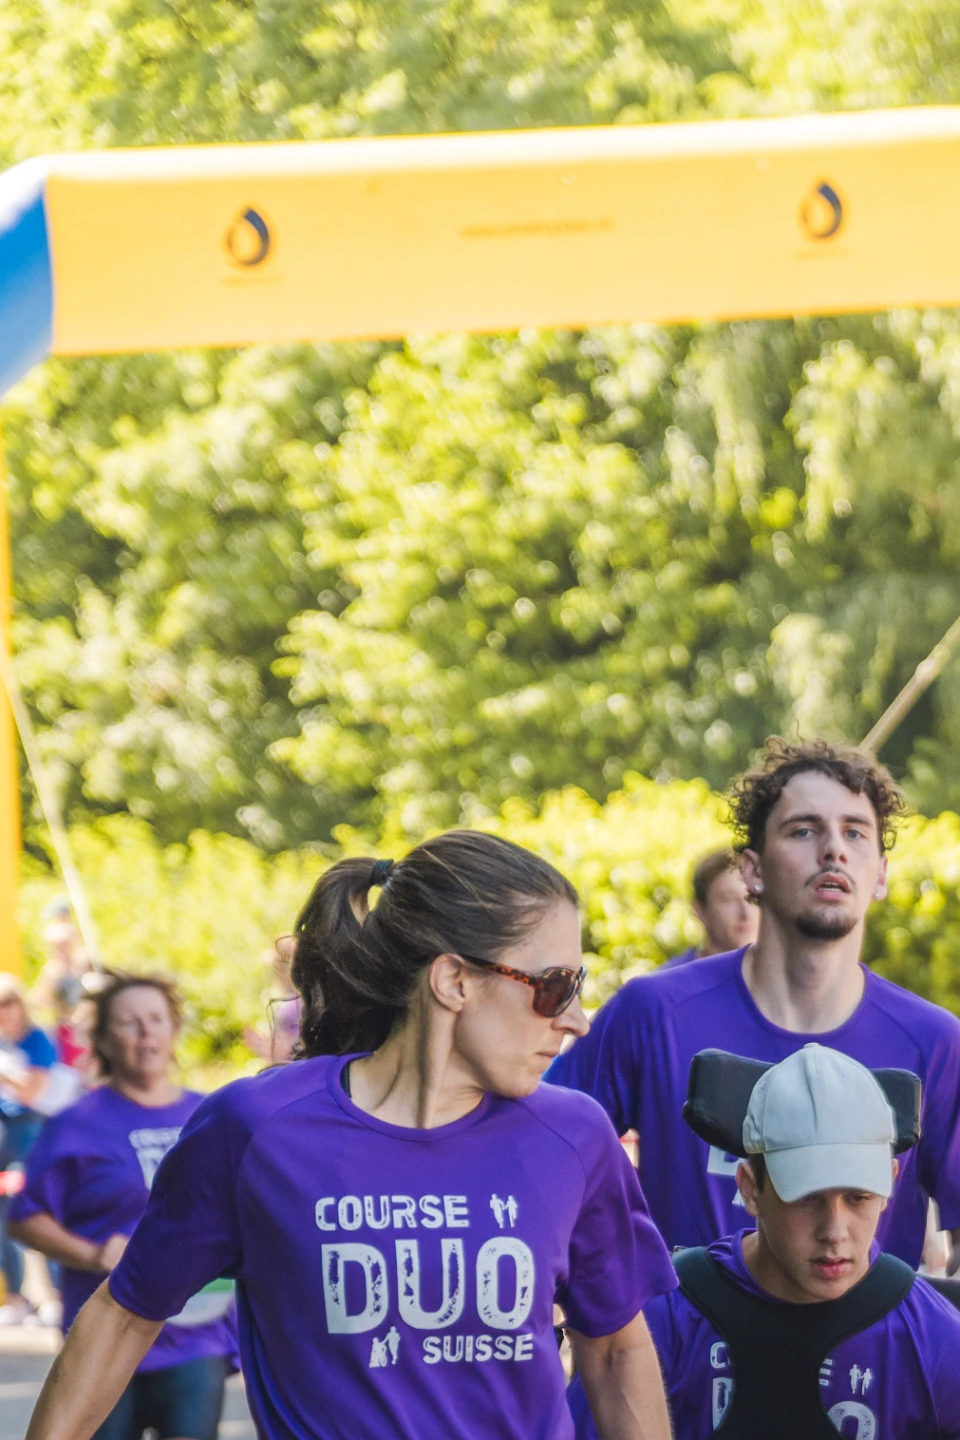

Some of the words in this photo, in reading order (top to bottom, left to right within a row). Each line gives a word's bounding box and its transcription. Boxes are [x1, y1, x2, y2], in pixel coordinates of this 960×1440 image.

[315, 1195, 469, 1231] COURSE
[321, 1236, 535, 1334] DUO
[422, 1333, 534, 1364] SUISSE
